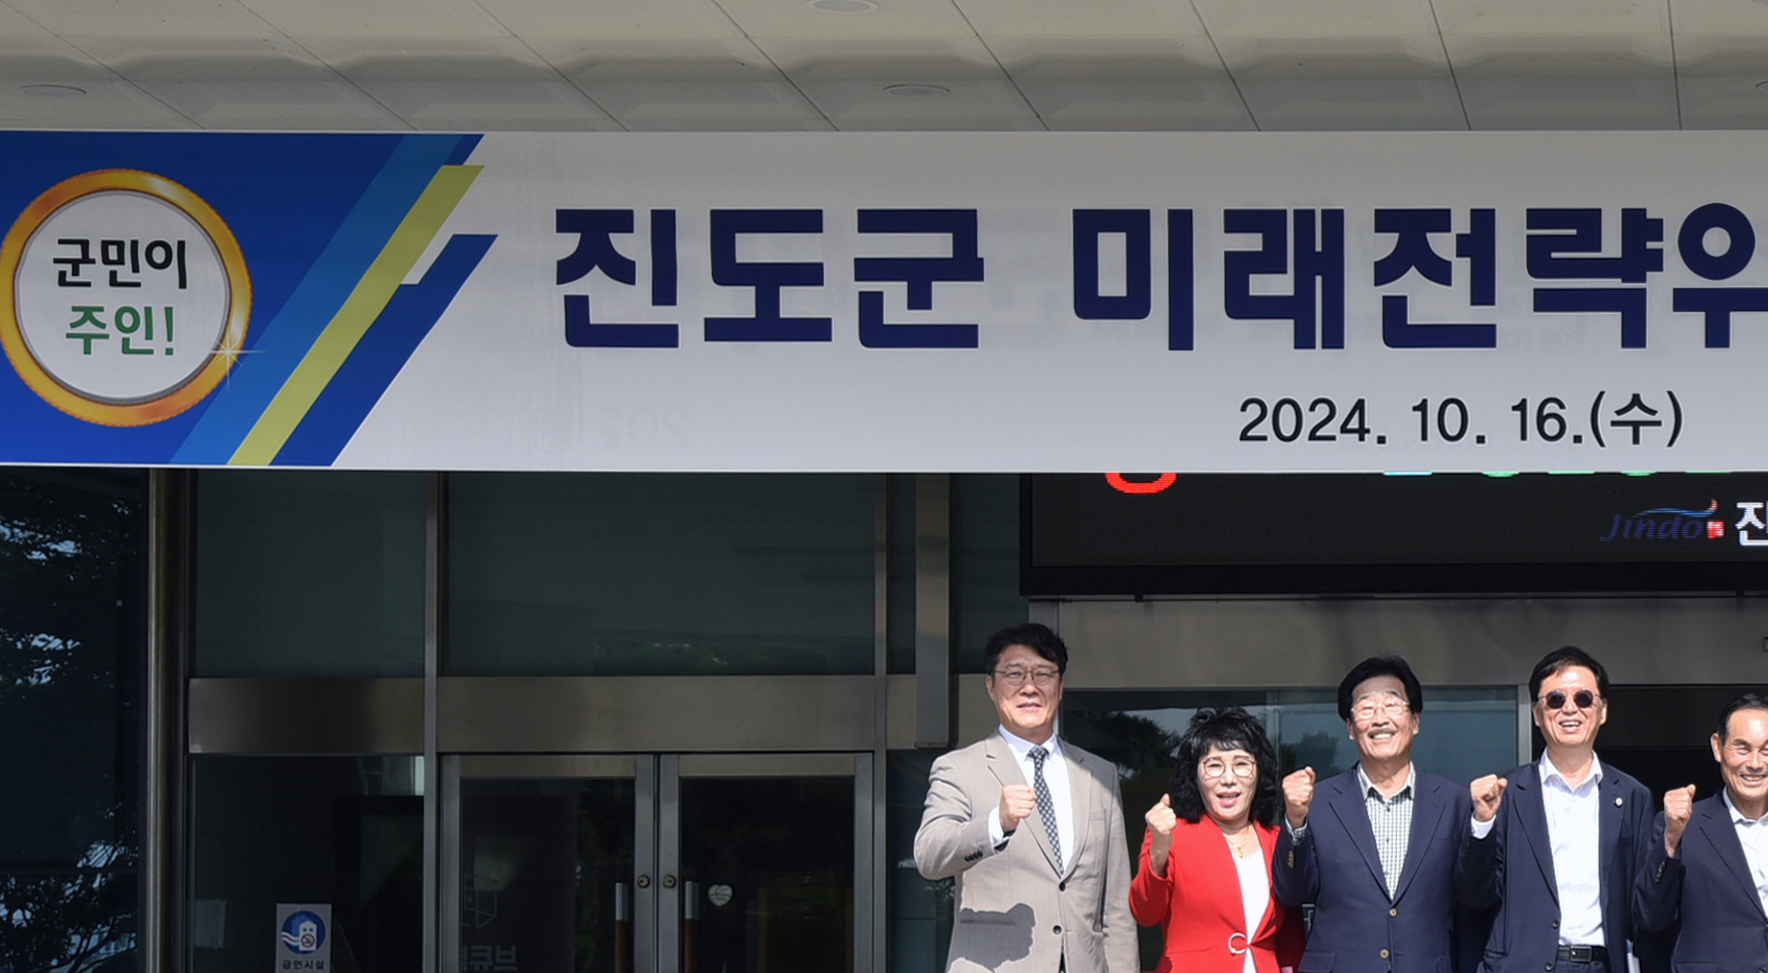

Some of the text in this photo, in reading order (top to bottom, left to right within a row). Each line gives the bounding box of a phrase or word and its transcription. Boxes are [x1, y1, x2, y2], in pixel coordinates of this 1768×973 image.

[53, 238, 188, 290] 군민이
[555, 208, 985, 349] 진도군
[65, 305, 174, 356] 주인!
[1239, 390, 1682, 448] 2024. 10. 16.(수)
[1599, 513, 1704, 542] Jindo
[282, 959, 325, 970] 금연시설
